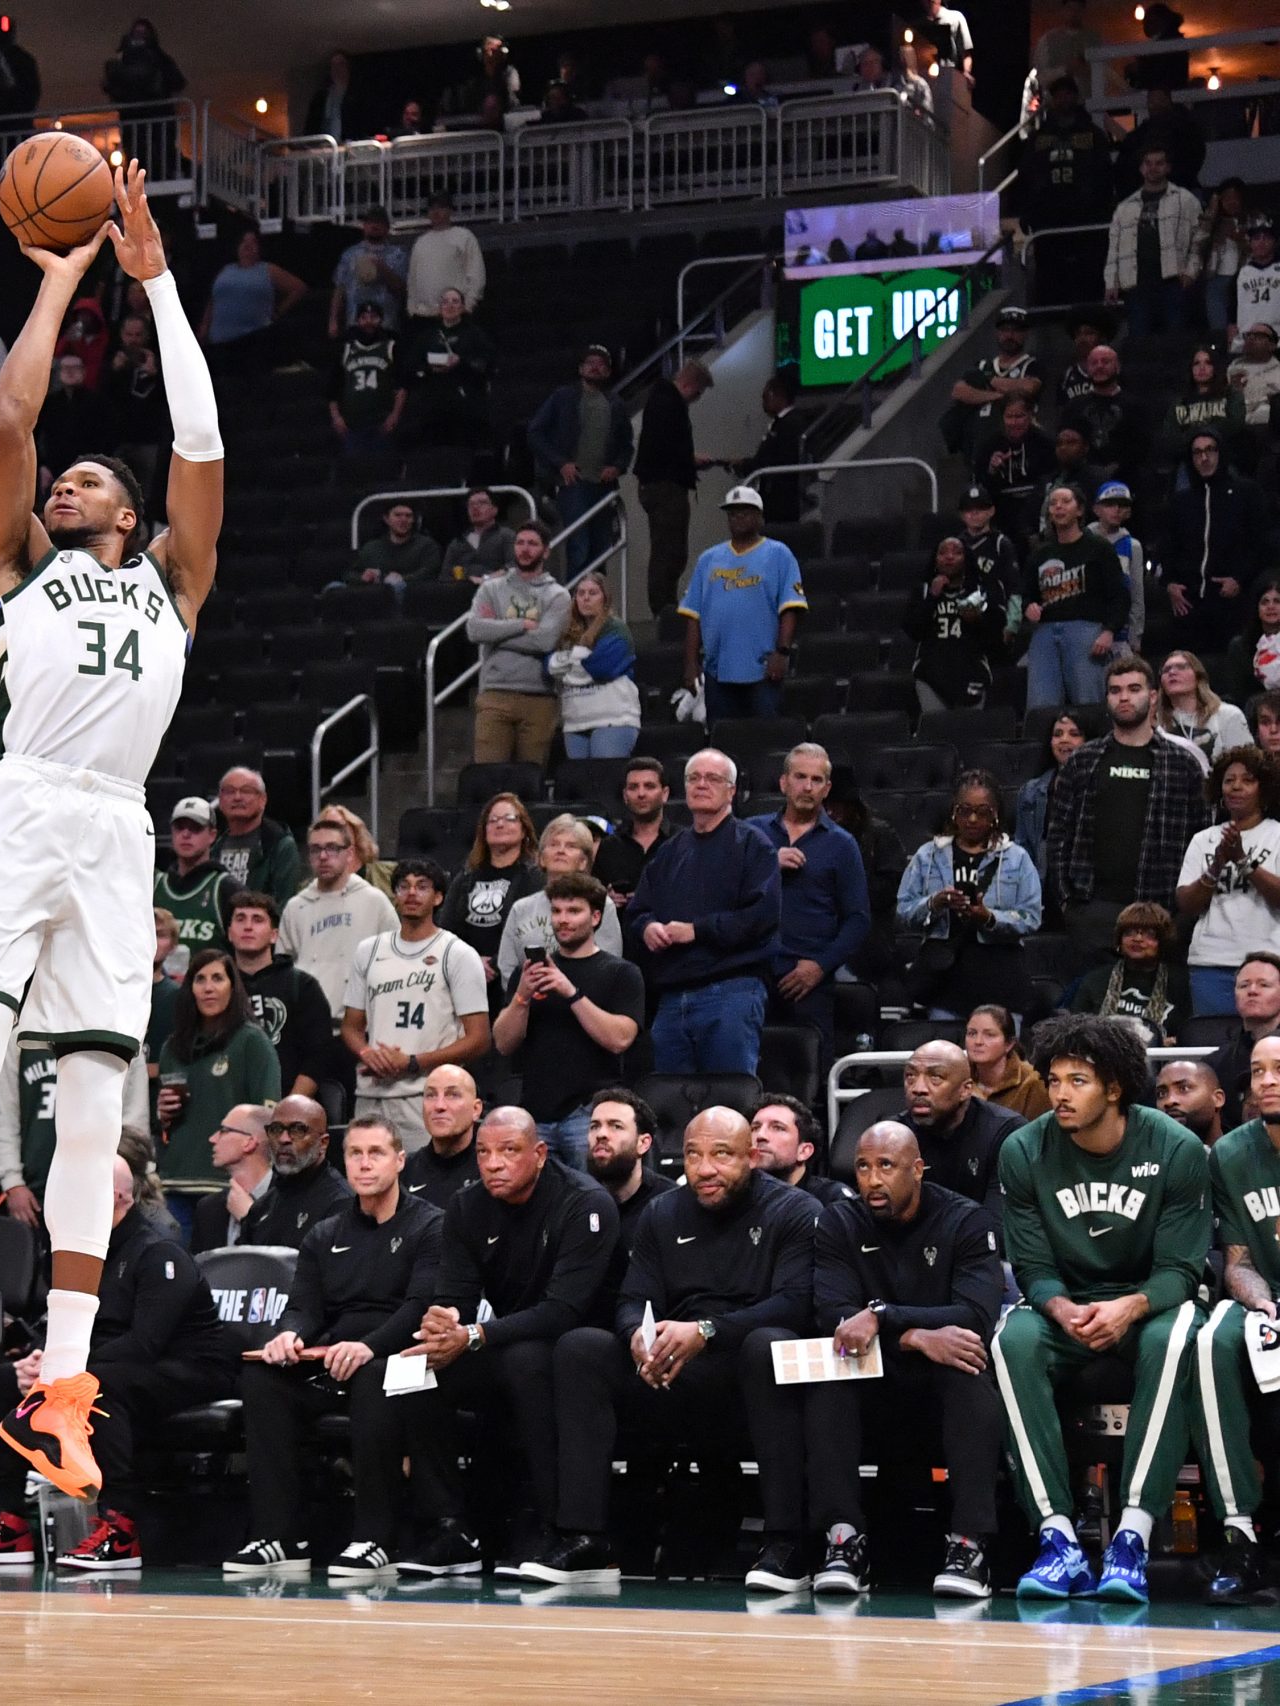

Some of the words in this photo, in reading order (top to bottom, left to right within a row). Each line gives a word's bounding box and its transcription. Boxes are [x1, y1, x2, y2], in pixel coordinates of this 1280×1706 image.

[1251, 288, 1270, 304] 34
[814, 306, 873, 359] GET
[892, 287, 959, 340] UP!!
[354, 370, 377, 391] 34
[42, 573, 164, 625] BUCKS
[937, 618, 962, 639] 34
[77, 620, 143, 682] 34
[1110, 766, 1150, 779] NIKE
[1205, 845, 1271, 865] BKS
[516, 916, 549, 938] MILW
[407, 970, 436, 993] City
[395, 1001, 425, 1030] 34
[24, 1058, 57, 1086] MILW
[38, 1083, 57, 1119] 3
[1055, 1182, 1147, 1221] BUCKS
[1243, 1186, 1280, 1223] BU
[210, 1289, 248, 1322] THE
[263, 1287, 289, 1327] Ap
